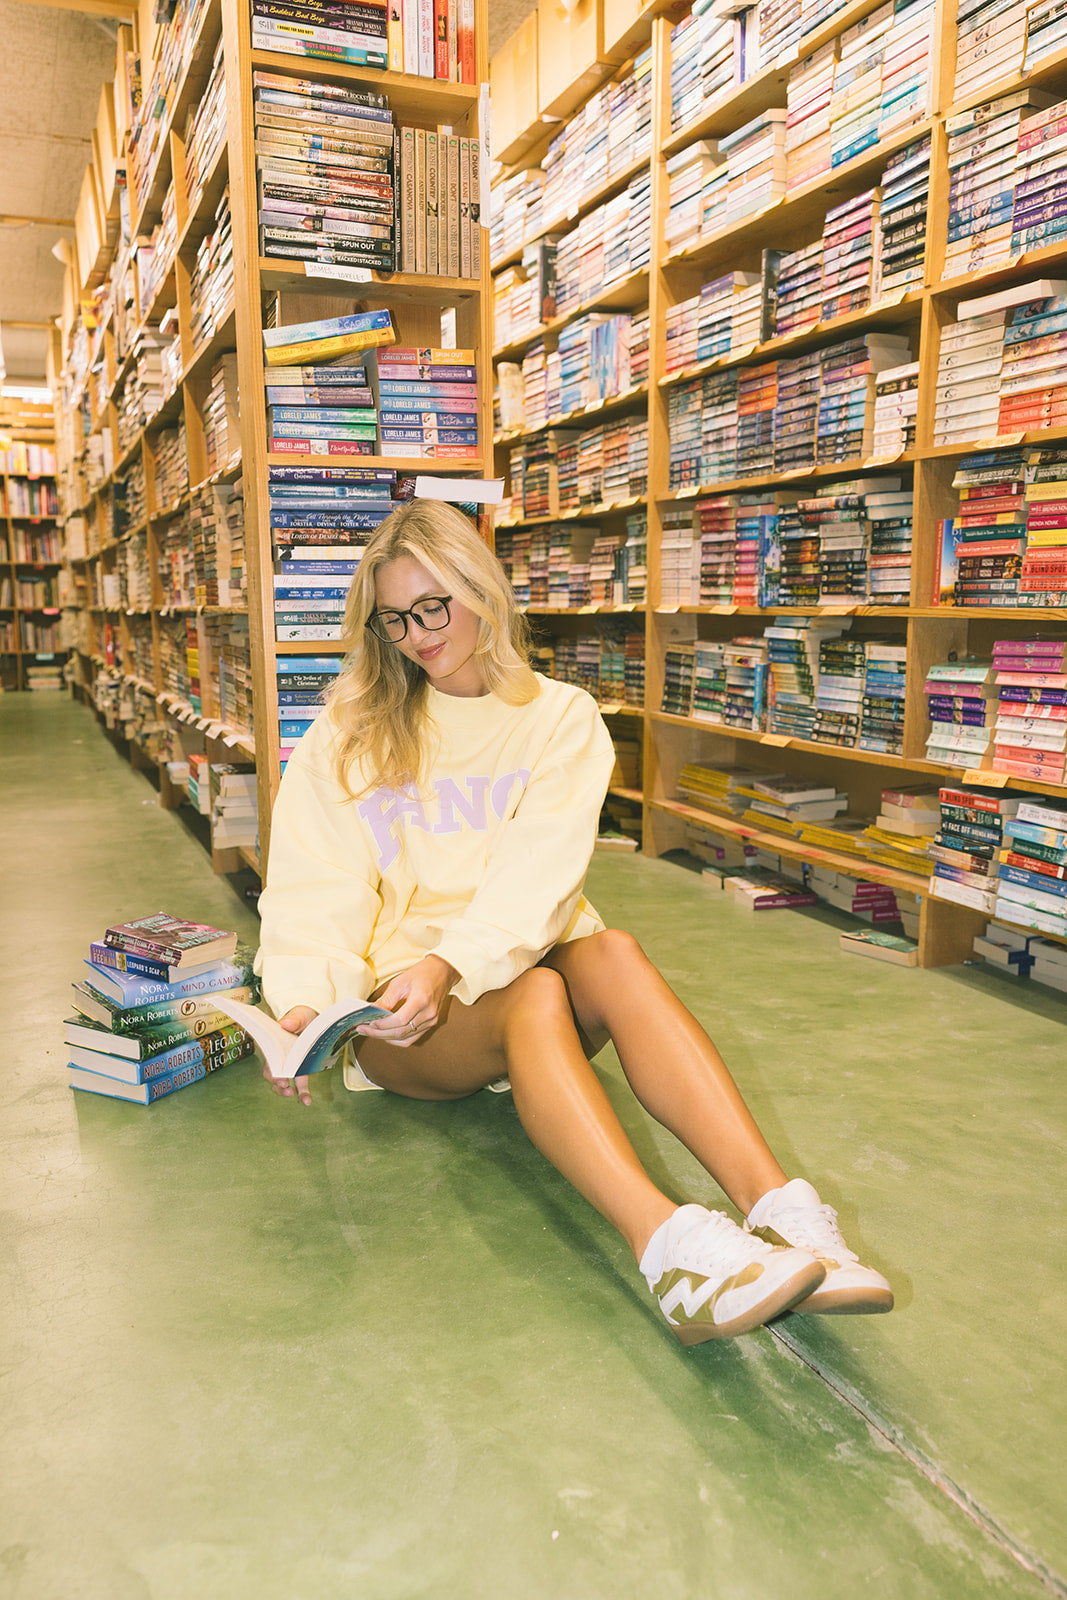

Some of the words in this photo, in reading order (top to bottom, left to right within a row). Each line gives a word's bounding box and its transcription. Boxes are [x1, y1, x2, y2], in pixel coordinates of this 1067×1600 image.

[269, 6, 294, 16] Baddest
[296, 10, 309, 19] Bad
[310, 14, 325, 23] Boys
[406, 174, 414, 211] CASANOVA
[341, 240, 359, 250] SPUN
[360, 241, 376, 251] OUT
[343, 318, 372, 330] CAGED
[343, 334, 373, 344] BOUND
[392, 384, 413, 393] LORELEI
[413, 385, 431, 394] JAMES
[392, 400, 413, 409] LORELEI
[413, 401, 431, 409] JAMES
[280, 411, 302, 420] LORELEI
[303, 412, 322, 420] JAMES
[383, 413, 404, 421] LORELEI
[384, 429, 404, 437] LORELEI
[405, 430, 421, 438] JAMES
[273, 441, 293, 449] LORELEI
[293, 442, 310, 450] JAMES
[318, 513, 341, 522] Through
[352, 513, 371, 522] Night
[1030, 565, 1049, 574] BLIND
[1050, 564, 1066, 573] SPOT
[1030, 580, 1048, 589] BLIND
[1049, 580, 1065, 588] SPOT
[948, 822, 960, 833] FACE
[961, 825, 971, 834] OFF
[971, 829, 987, 838] BRENDA
[987, 832, 1000, 841] NOVAK
[92, 950, 116, 967] FEEHAN
[126, 961, 149, 973] LEOPARD'S
[148, 966, 160, 976] SCAR
[140, 983, 169, 996] NORA
[181, 982, 206, 993] MIND
[208, 975, 240, 988] GAMES
[134, 992, 176, 1007] ROBERTS
[120, 1014, 145, 1027] NORA
[146, 1008, 179, 1021] ROBERTS
[147, 1040, 166, 1053] NORA
[168, 1030, 193, 1045] ROBERTS
[144, 1060, 166, 1079] NORA
[167, 1046, 201, 1070] ROBERTS
[209, 1030, 247, 1055] LEGACY
[152, 1078, 172, 1099] NORA
[173, 1064, 203, 1088] ROBERTS
[209, 1045, 244, 1072] LEGACY
